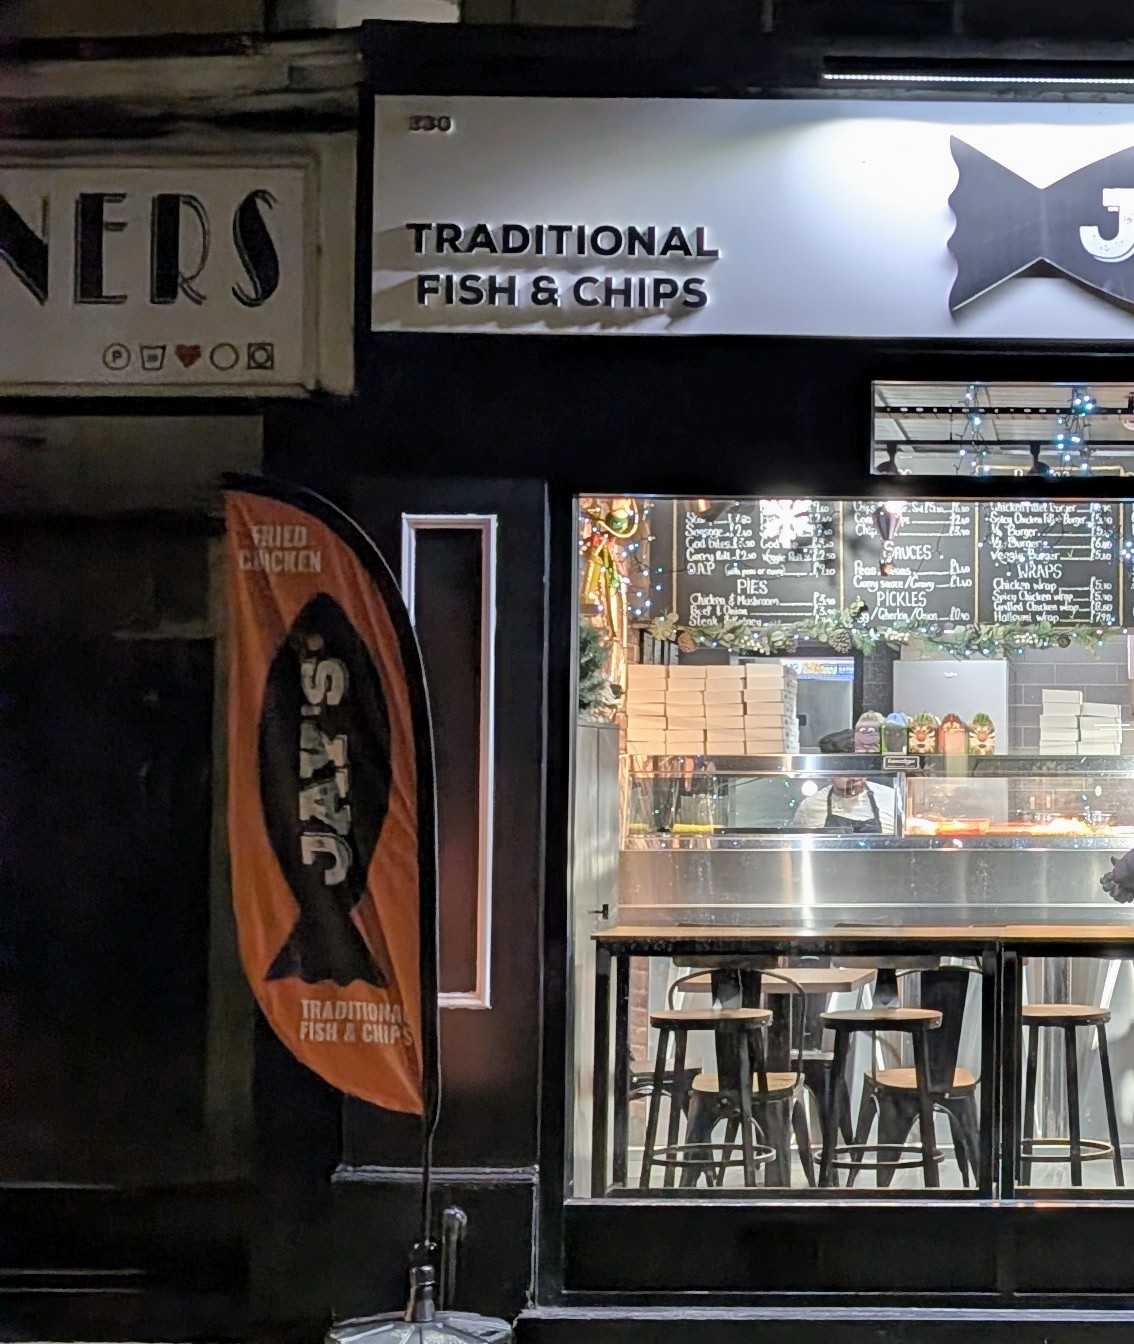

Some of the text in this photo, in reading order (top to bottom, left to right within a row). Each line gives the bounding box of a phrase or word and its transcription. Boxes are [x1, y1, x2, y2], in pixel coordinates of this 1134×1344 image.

[406, 222, 722, 259] TRADITIONAL
[416, 274, 710, 309] FISH & CHIPS
[1013, 511, 1042, 525] Chicken
[1062, 513, 1088, 527] Burger
[250, 525, 306, 548] FRIED
[1007, 524, 1038, 539] Burger
[685, 536, 706, 548] Cod
[1008, 537, 1041, 551] Burger
[882, 541, 932, 560] SAUCES
[1028, 549, 1060, 564] Burger
[1017, 564, 1063, 579] WRAPS
[737, 578, 768, 595] PIES
[993, 578, 1057, 593] Chicken wrap
[689, 593, 725, 605] Chicken
[737, 595, 780, 606] Mushroom
[876, 591, 927, 607] PICKLES
[992, 590, 1074, 604] Spicy Chicken wrap
[993, 601, 1024, 612] Grilled
[1026, 601, 1057, 612] Chicken
[1036, 610, 1059, 624] wrap
[299, 658, 352, 886] JAY'S
[300, 1021, 338, 1042] FISH
[362, 1023, 412, 1046] CHIPS
